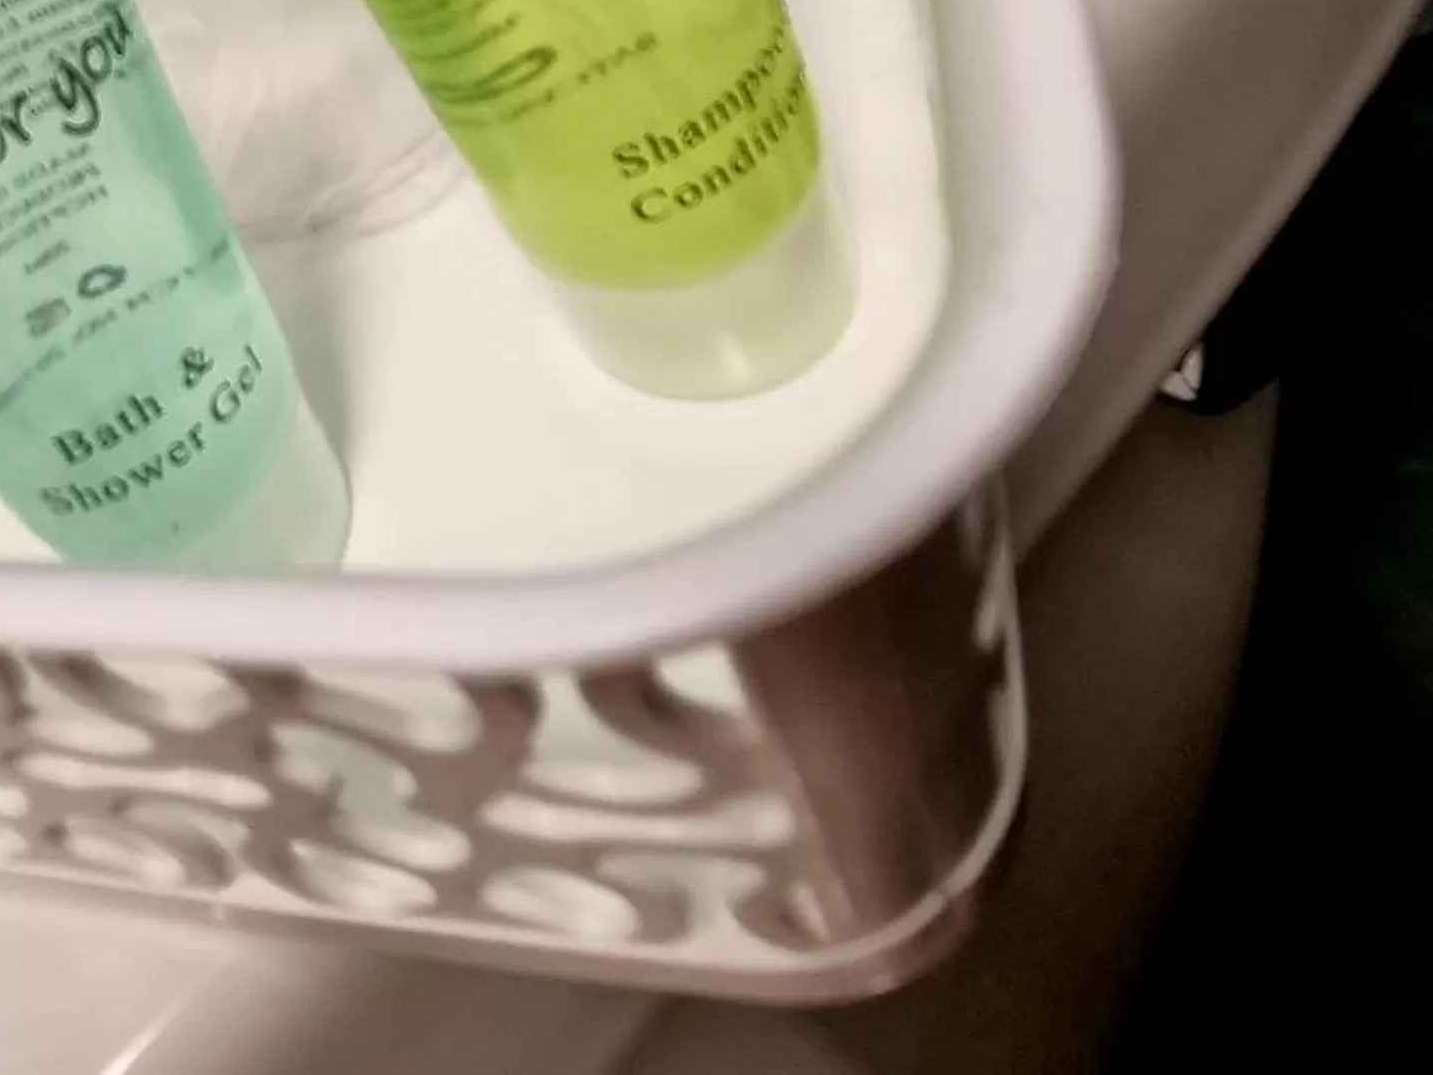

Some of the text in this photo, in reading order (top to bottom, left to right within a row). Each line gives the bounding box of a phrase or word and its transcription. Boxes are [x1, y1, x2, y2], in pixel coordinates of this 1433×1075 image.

[49, 2, 136, 137] you
[39, 344, 266, 519] Shower Gel
[51, 346, 218, 468] Bath &
